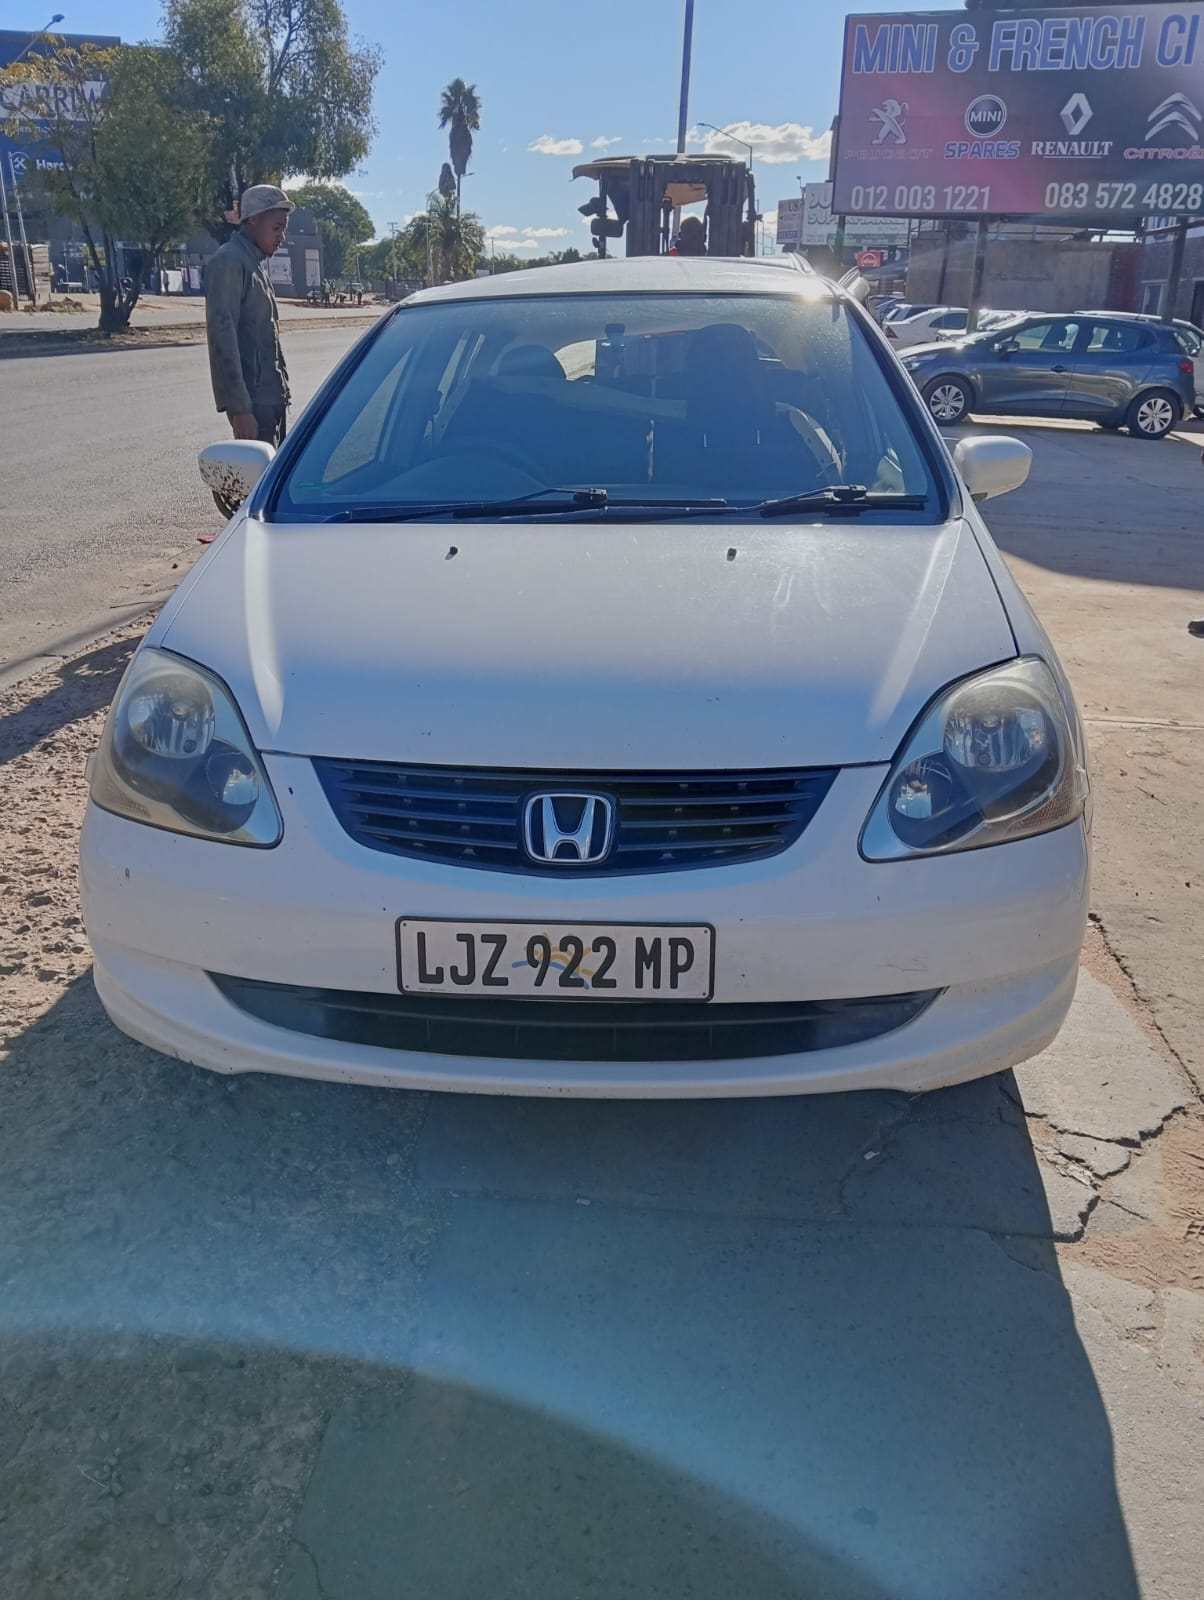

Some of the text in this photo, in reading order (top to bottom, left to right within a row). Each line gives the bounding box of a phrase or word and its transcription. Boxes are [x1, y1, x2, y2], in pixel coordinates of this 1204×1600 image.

[852, 13, 1204, 74] MINI & FRENCH CI
[970, 110, 1002, 123] MINI
[944, 141, 1021, 159] SPARES
[1031, 141, 1113, 157] RENAULT
[851, 185, 991, 211] 012 003 1221
[1045, 183, 1203, 210] 083 572 4828
[417, 931, 695, 990] LJZ 922 MP
